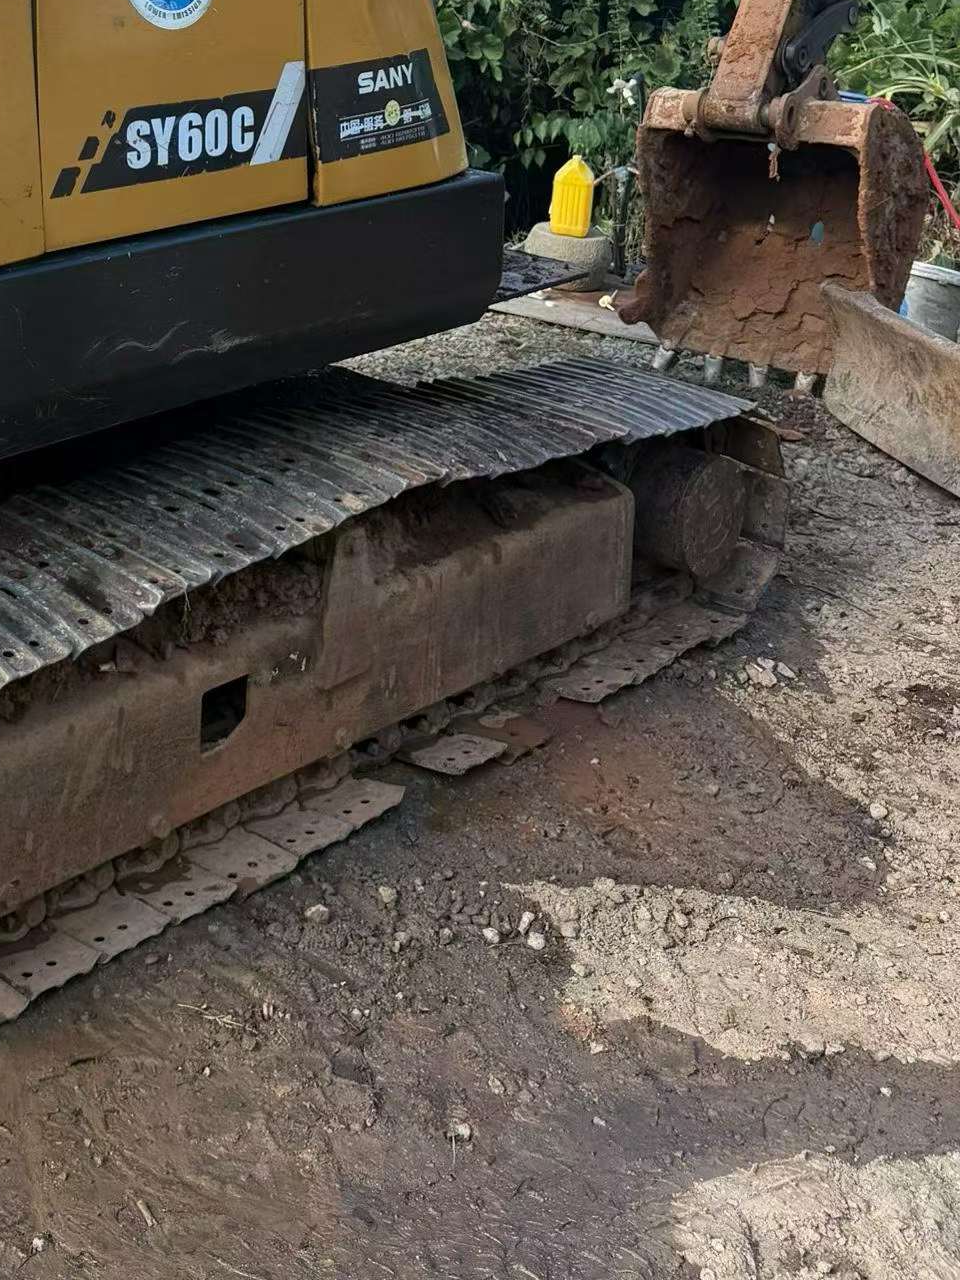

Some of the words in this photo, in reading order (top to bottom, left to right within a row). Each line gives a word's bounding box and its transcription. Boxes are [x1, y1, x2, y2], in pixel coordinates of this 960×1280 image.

[144, 1, 166, 19] LOWER
[357, 62, 413, 95] SANY
[126, 105, 255, 170] SY60C
